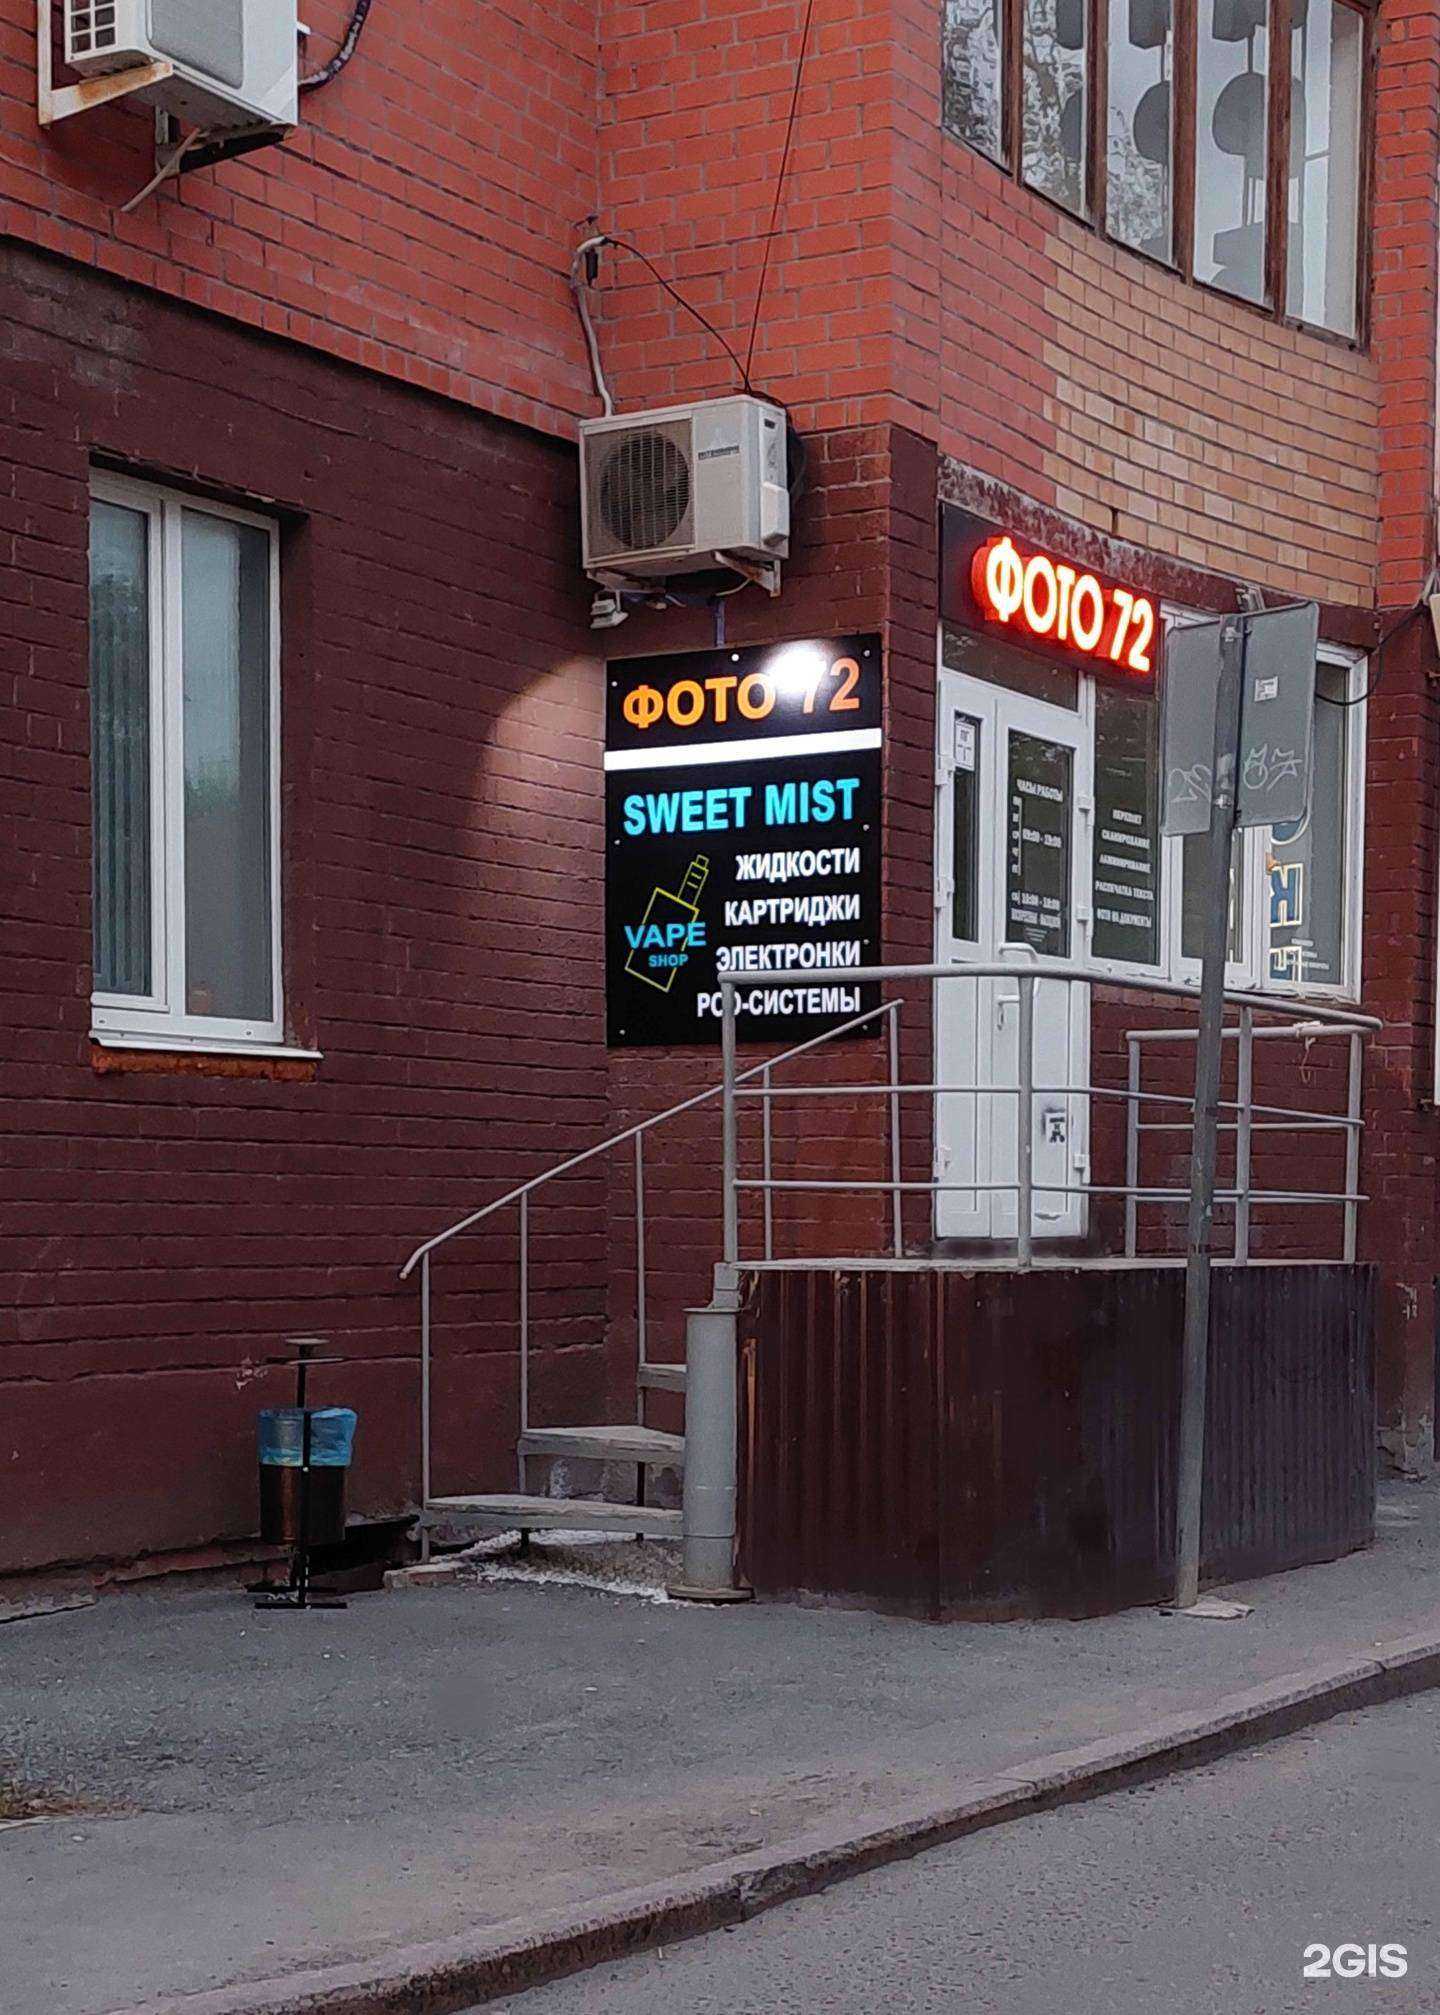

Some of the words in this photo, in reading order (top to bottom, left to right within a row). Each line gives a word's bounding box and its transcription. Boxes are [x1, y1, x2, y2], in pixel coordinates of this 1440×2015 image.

[984, 536, 1104, 651] ФОТО
[1112, 588, 1154, 673] 72
[623, 672, 776, 729] ФОТО
[623, 786, 752, 836] SWEET
[764, 778, 861, 826] MIST
[735, 847, 861, 883] ЖИДКОСТИ
[724, 894, 861, 927] КАРТРИДЖИ
[624, 921, 707, 949] VAPE
[648, 953, 689, 968] SHOP
[716, 940, 861, 972] ЭЛЕКТРОНКИ
